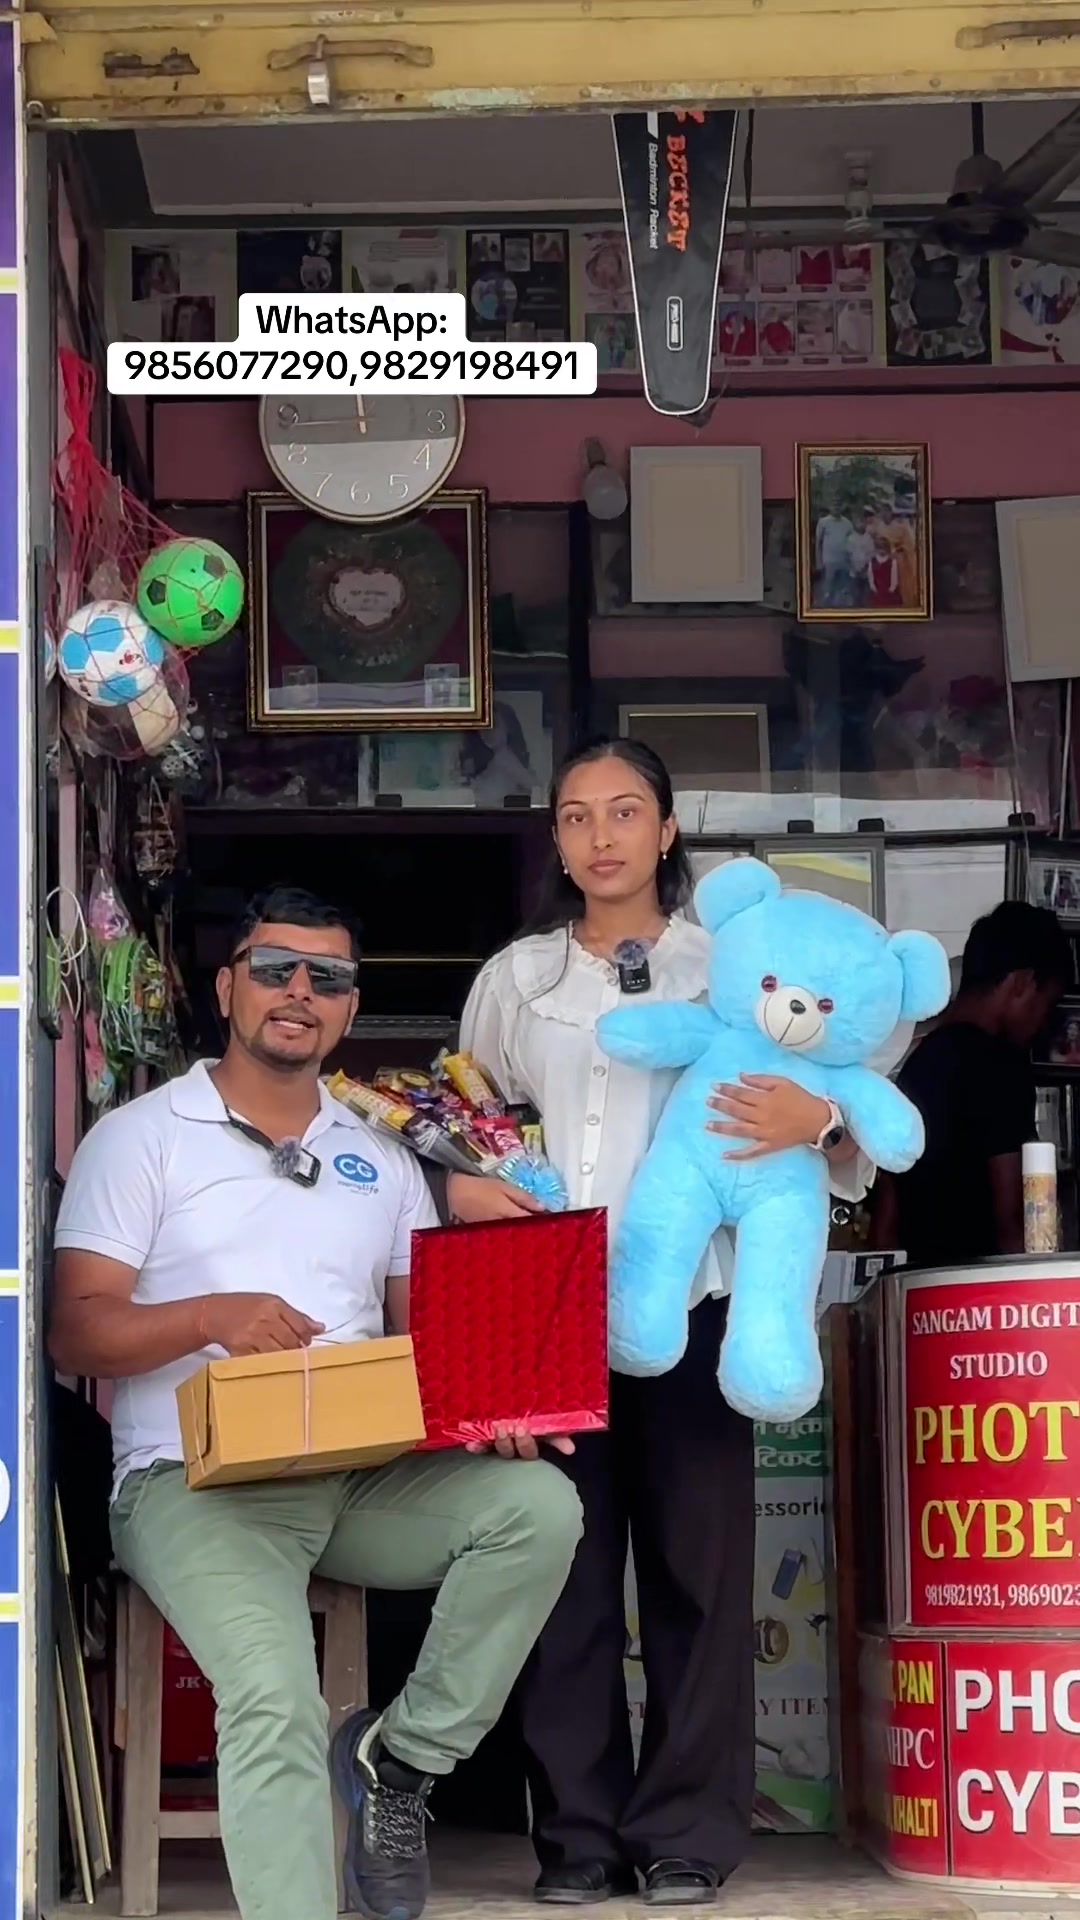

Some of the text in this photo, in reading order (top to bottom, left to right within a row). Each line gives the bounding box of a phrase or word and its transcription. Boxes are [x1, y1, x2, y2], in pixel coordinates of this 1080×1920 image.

[426, 409, 446, 434] 3
[412, 442, 431, 470] 4
[313, 471, 334, 497] 7
[350, 480, 371, 505] 6
[388, 473, 409, 499] 5
[339, 1157, 373, 1179] CG
[912, 1305, 993, 1335] SANGAM
[950, 1350, 1048, 1379] STUDIO
[913, 1401, 1080, 1464] PHOT
[921, 1498, 1080, 1559] CYBE
